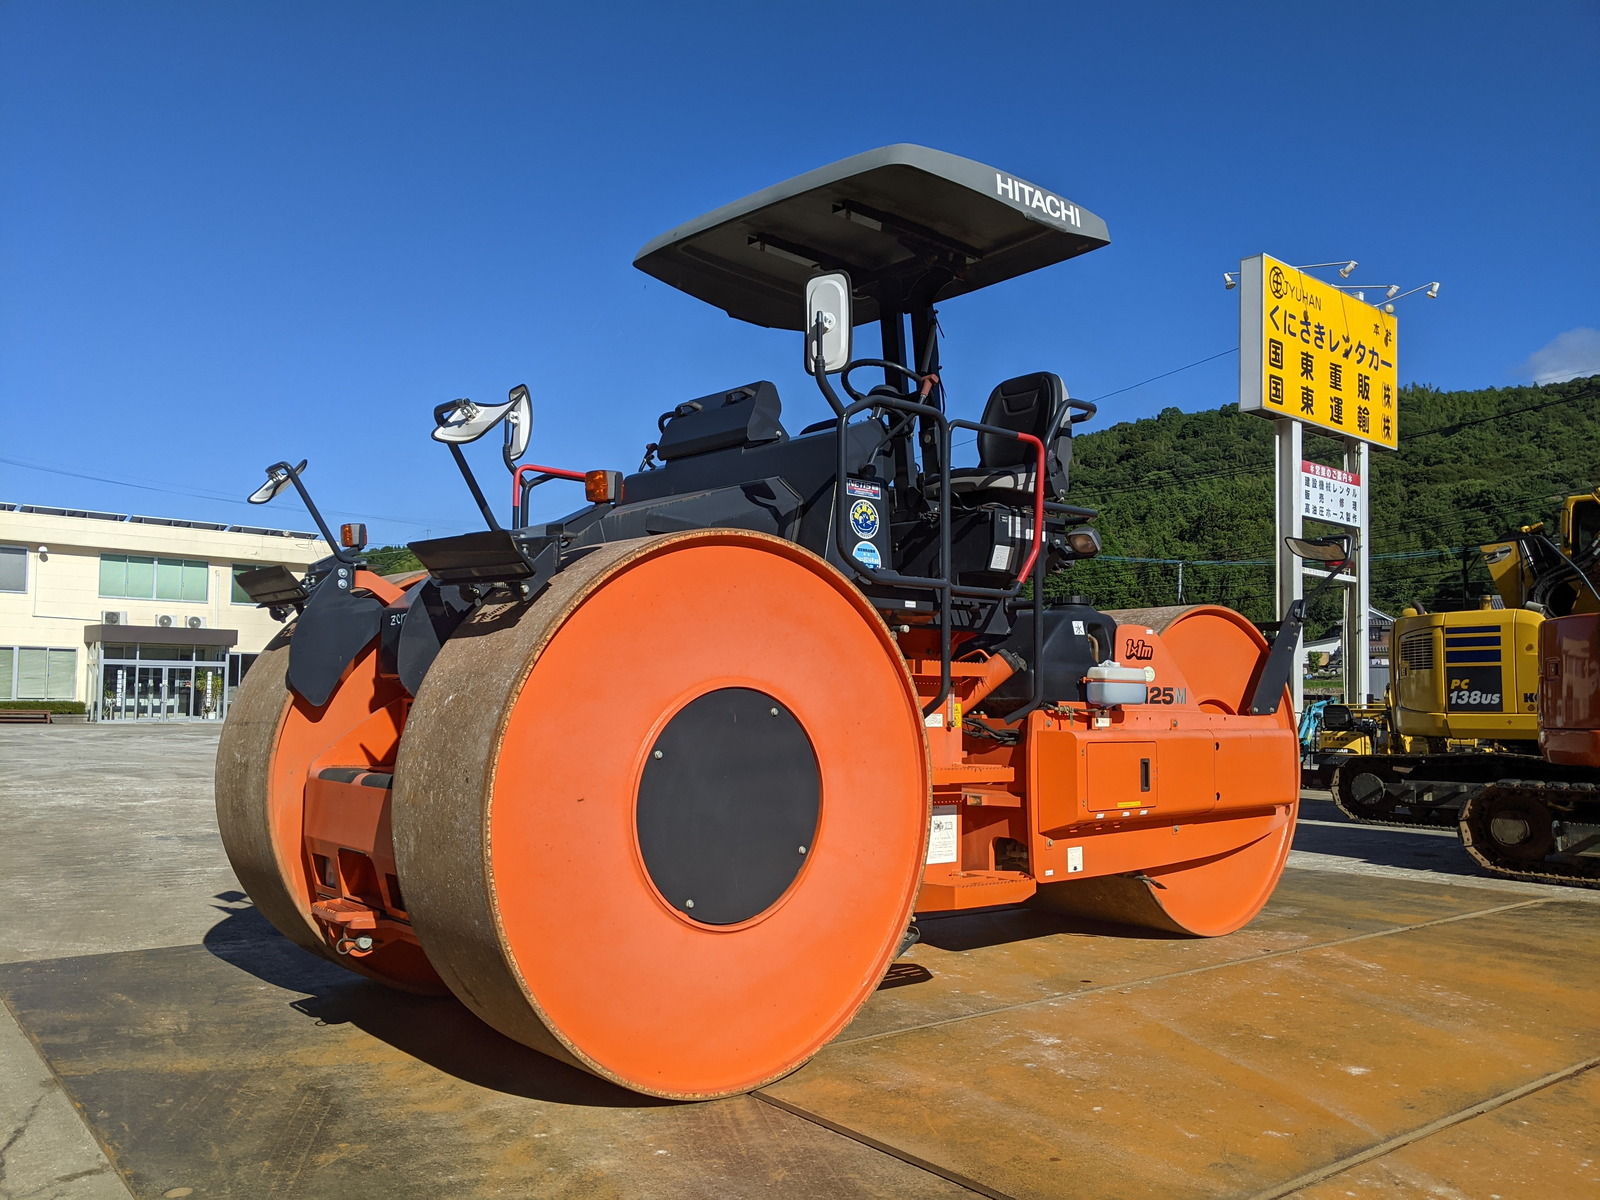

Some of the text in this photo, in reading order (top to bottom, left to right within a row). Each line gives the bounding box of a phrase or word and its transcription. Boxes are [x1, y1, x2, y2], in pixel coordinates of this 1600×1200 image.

[996, 173, 1081, 228] HITACHI
[1282, 280, 1322, 311] JYUHAN
[1269, 305, 1392, 371] くにさきレンタカー
[1450, 678, 1470, 690] PC
